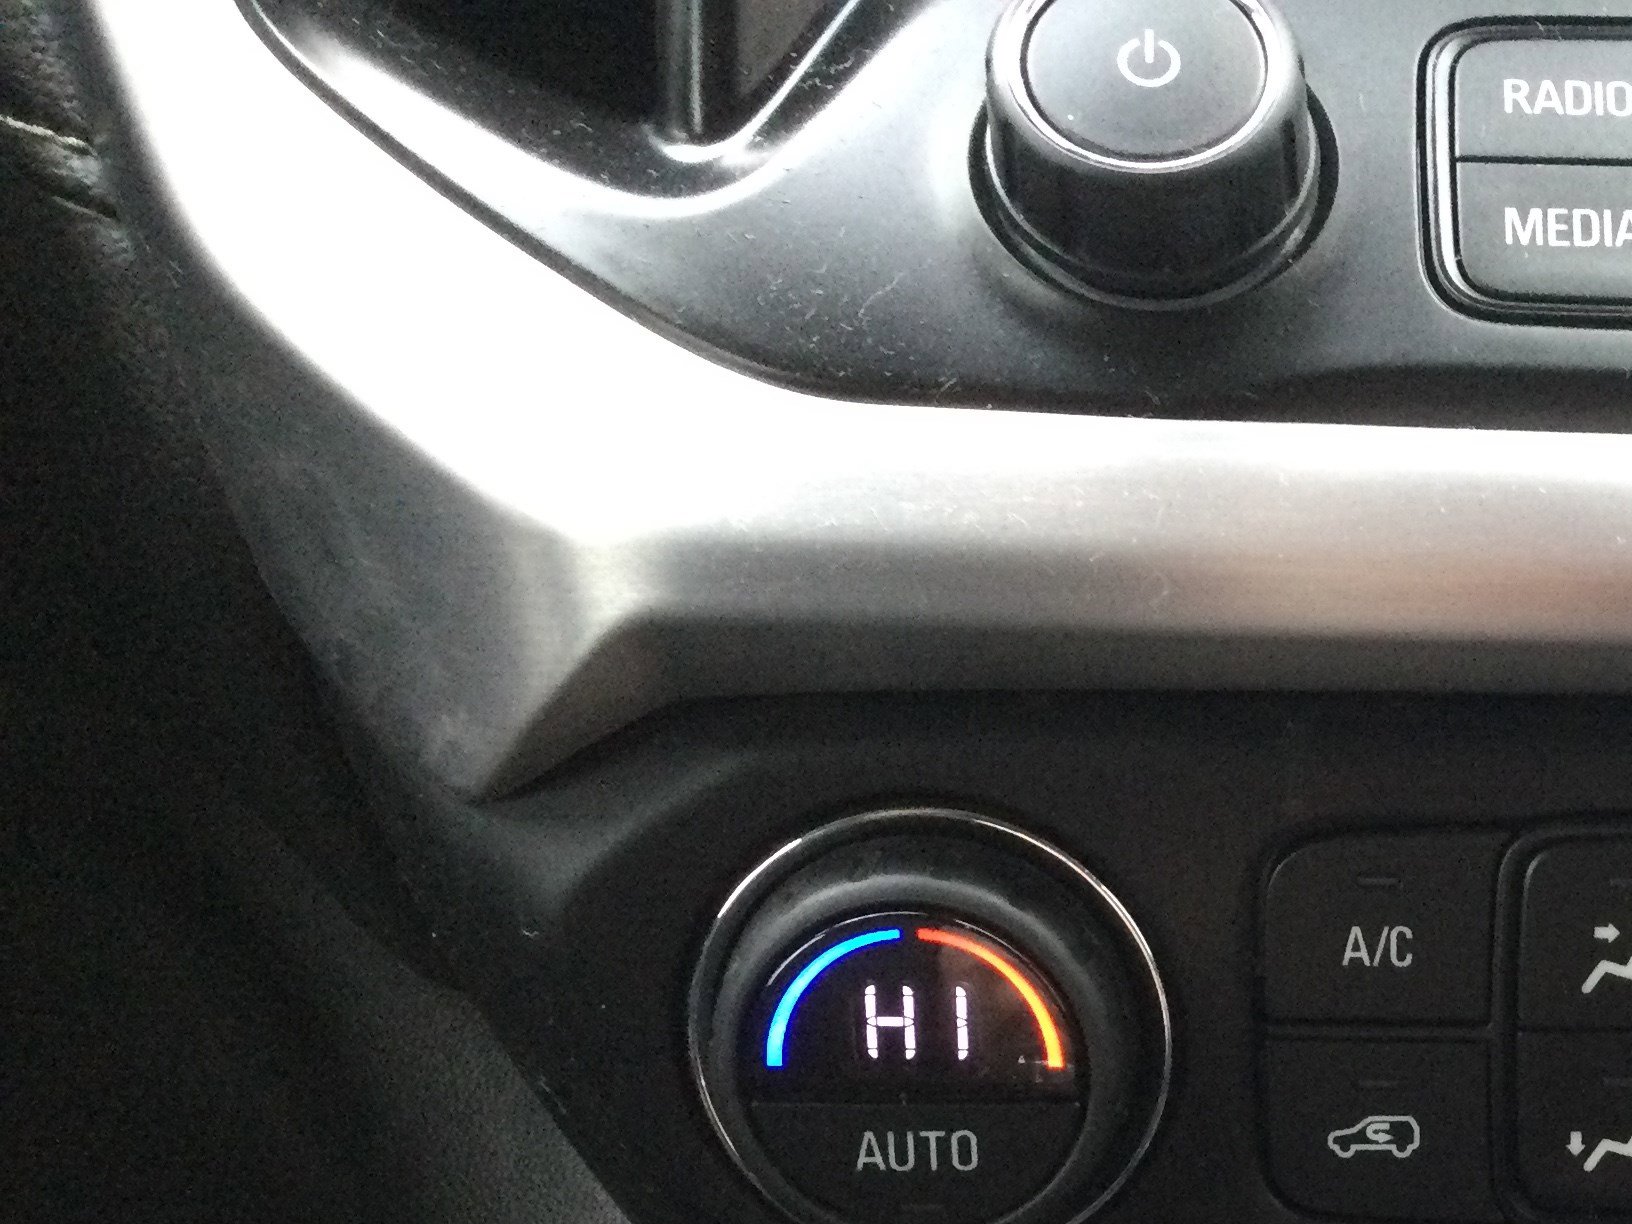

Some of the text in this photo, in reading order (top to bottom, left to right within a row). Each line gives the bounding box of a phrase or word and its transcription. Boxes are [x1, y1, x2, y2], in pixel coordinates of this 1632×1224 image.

[1342, 925, 1413, 967] A/C
[864, 984, 969, 1060] HI
[855, 1129, 979, 1172] AUTO
